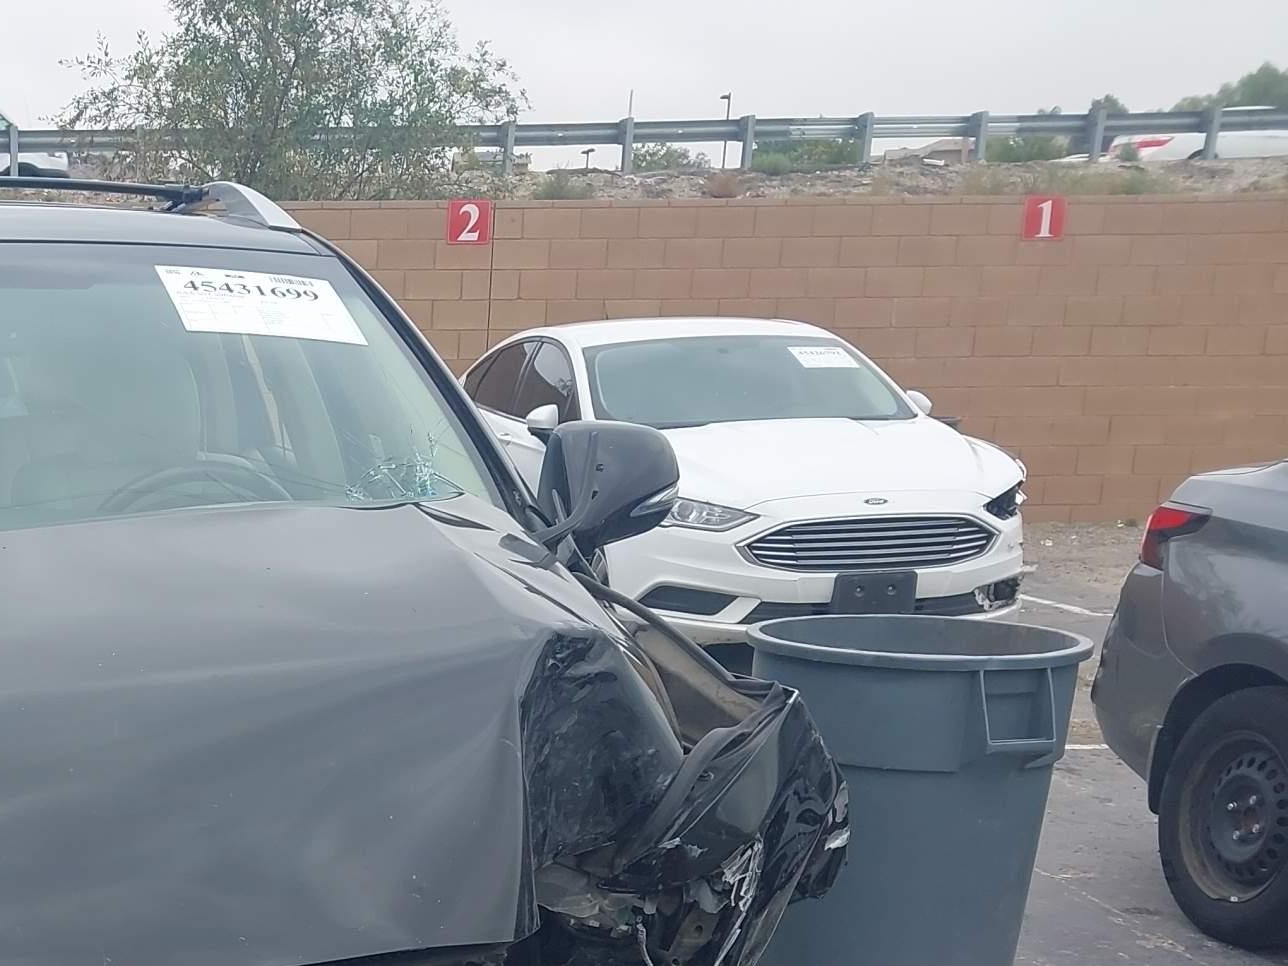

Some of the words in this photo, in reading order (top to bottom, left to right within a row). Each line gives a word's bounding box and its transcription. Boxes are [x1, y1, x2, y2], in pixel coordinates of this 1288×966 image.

[456, 204, 480, 243] 2
[1035, 200, 1054, 238] 1
[183, 280, 319, 301] 45431699
